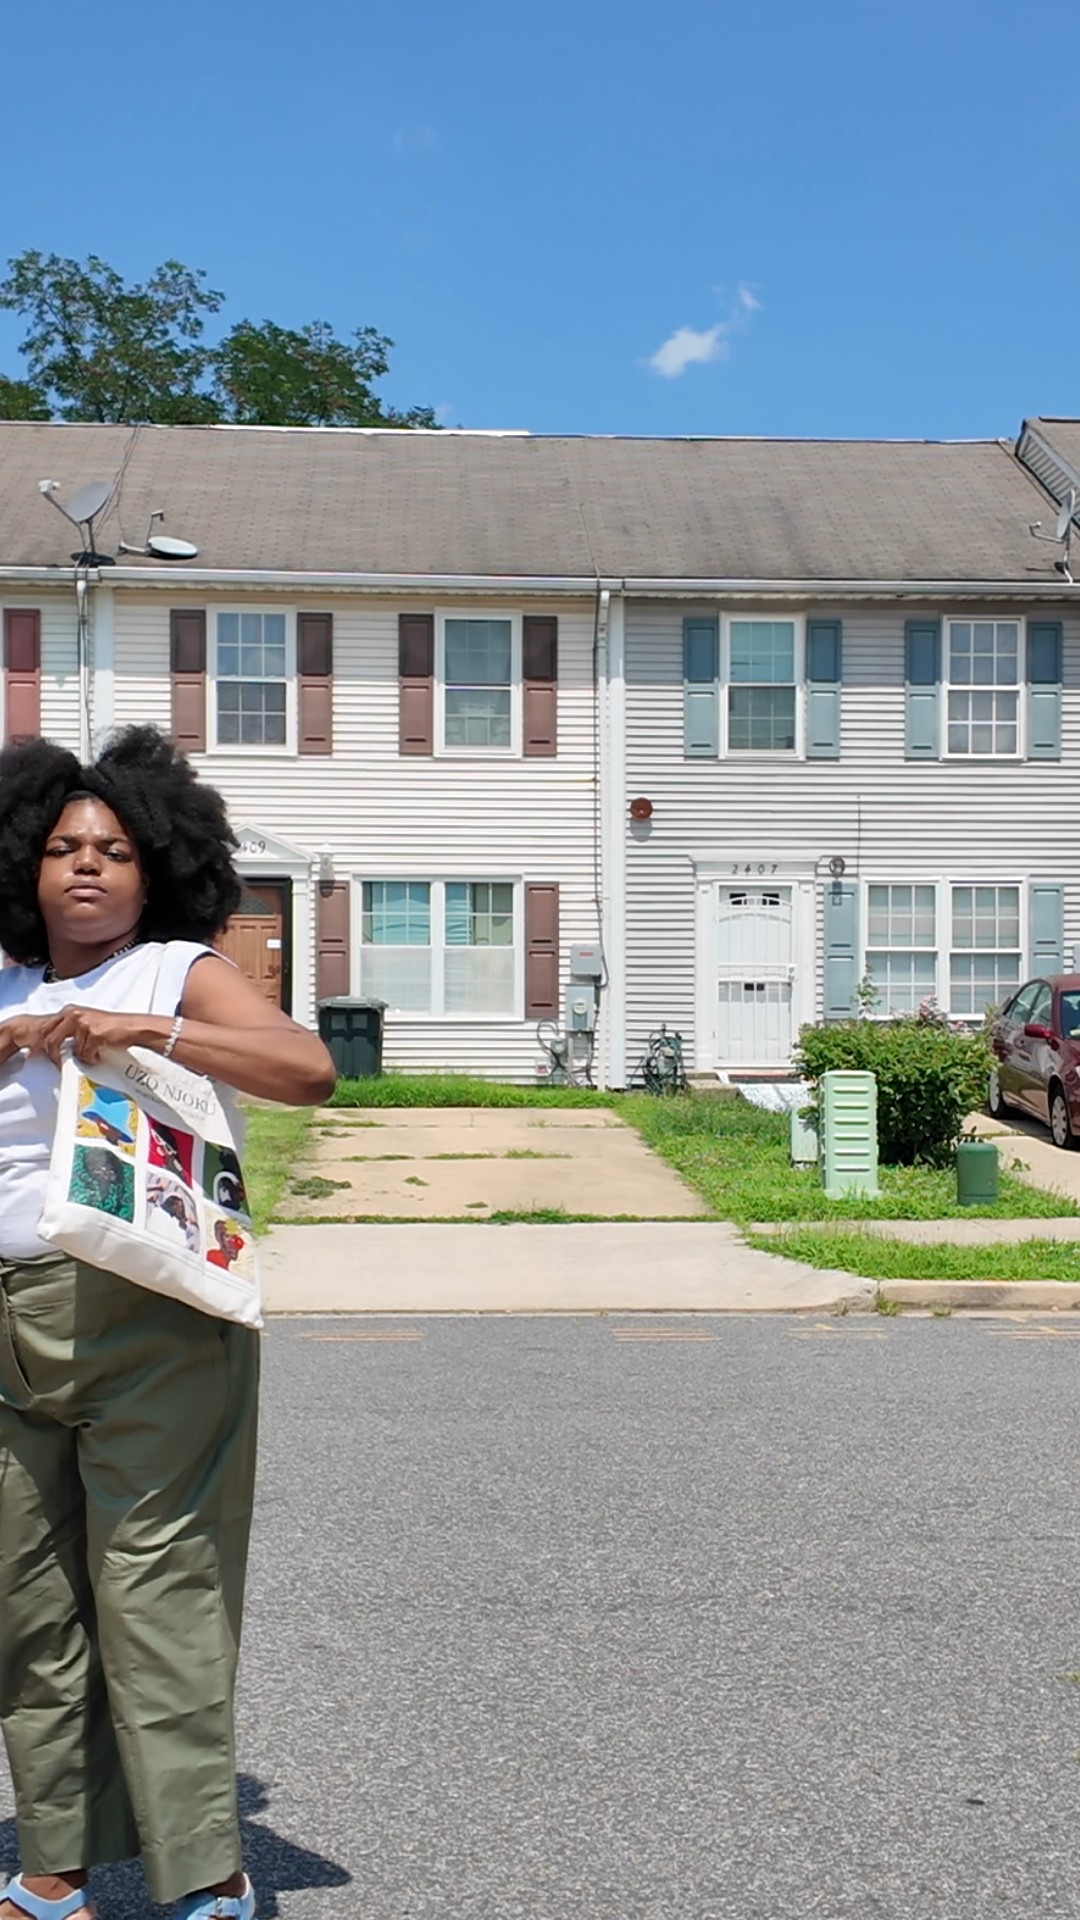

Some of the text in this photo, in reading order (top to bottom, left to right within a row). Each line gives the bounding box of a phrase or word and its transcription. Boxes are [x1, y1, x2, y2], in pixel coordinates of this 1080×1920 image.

[236, 840, 265, 854] 409
[731, 863, 779, 876] 2407
[125, 1063, 159, 1091] UZO
[163, 1083, 217, 1116] NJOKU
